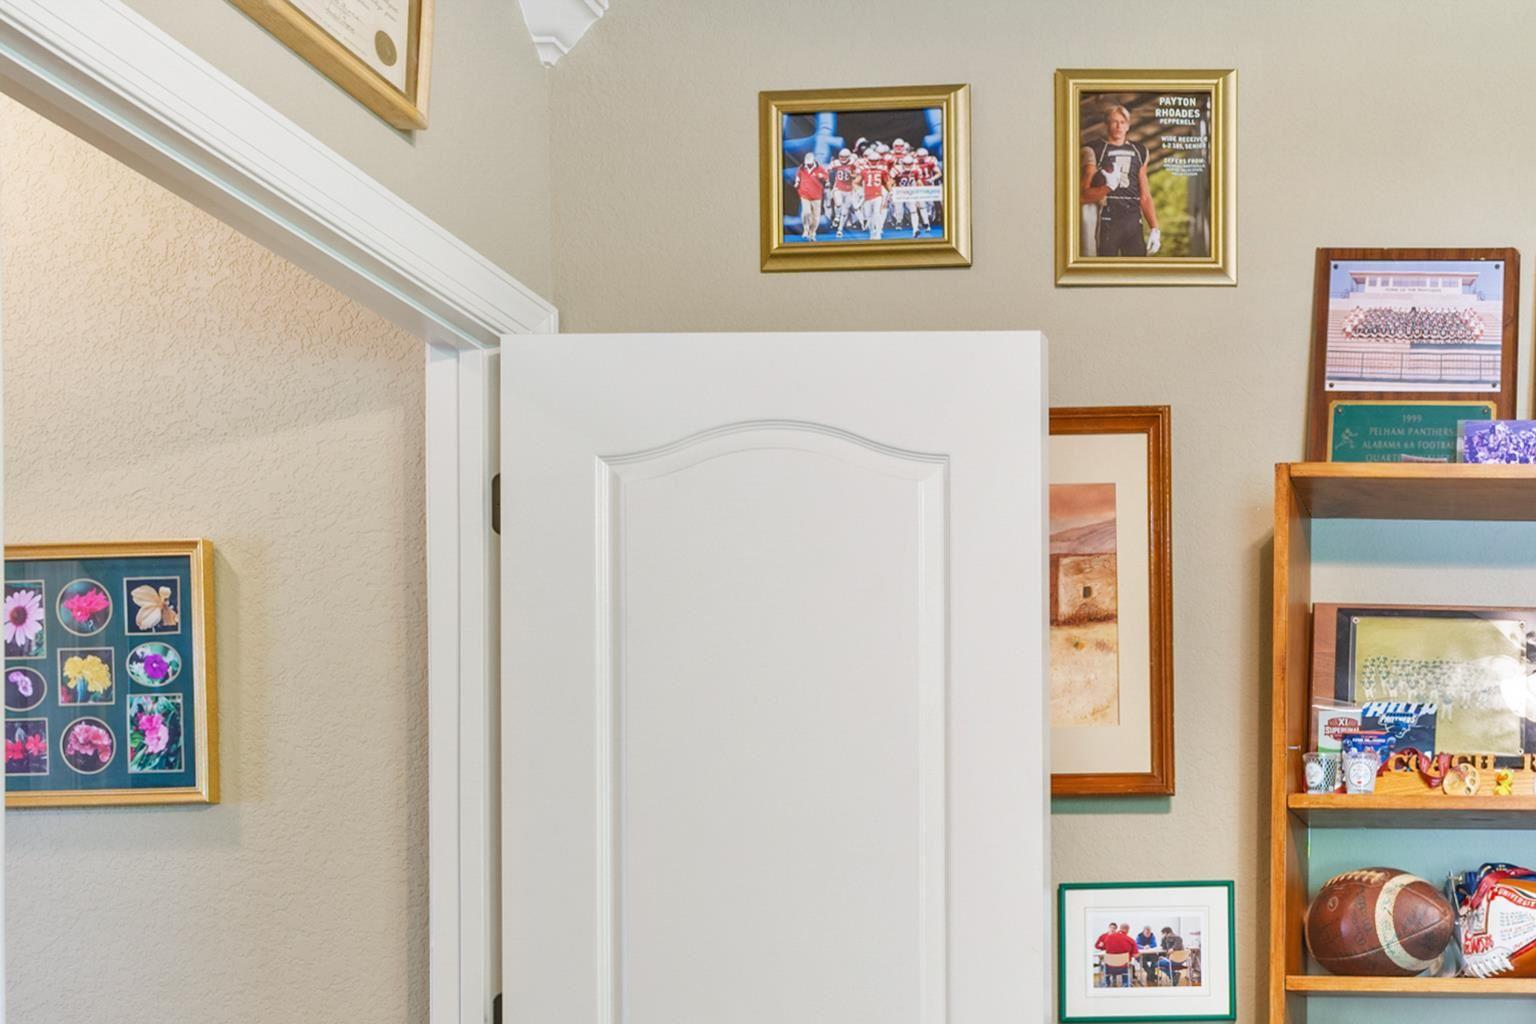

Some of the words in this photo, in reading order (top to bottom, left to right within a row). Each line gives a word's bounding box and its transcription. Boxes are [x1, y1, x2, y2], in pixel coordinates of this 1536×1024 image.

[1159, 96, 1197, 107] PAYTON
[1155, 108, 1201, 118] RHOADES
[866, 173, 882, 187] 15
[1402, 414, 1422, 423] 1999
[1369, 427, 1405, 436] PELHAM
